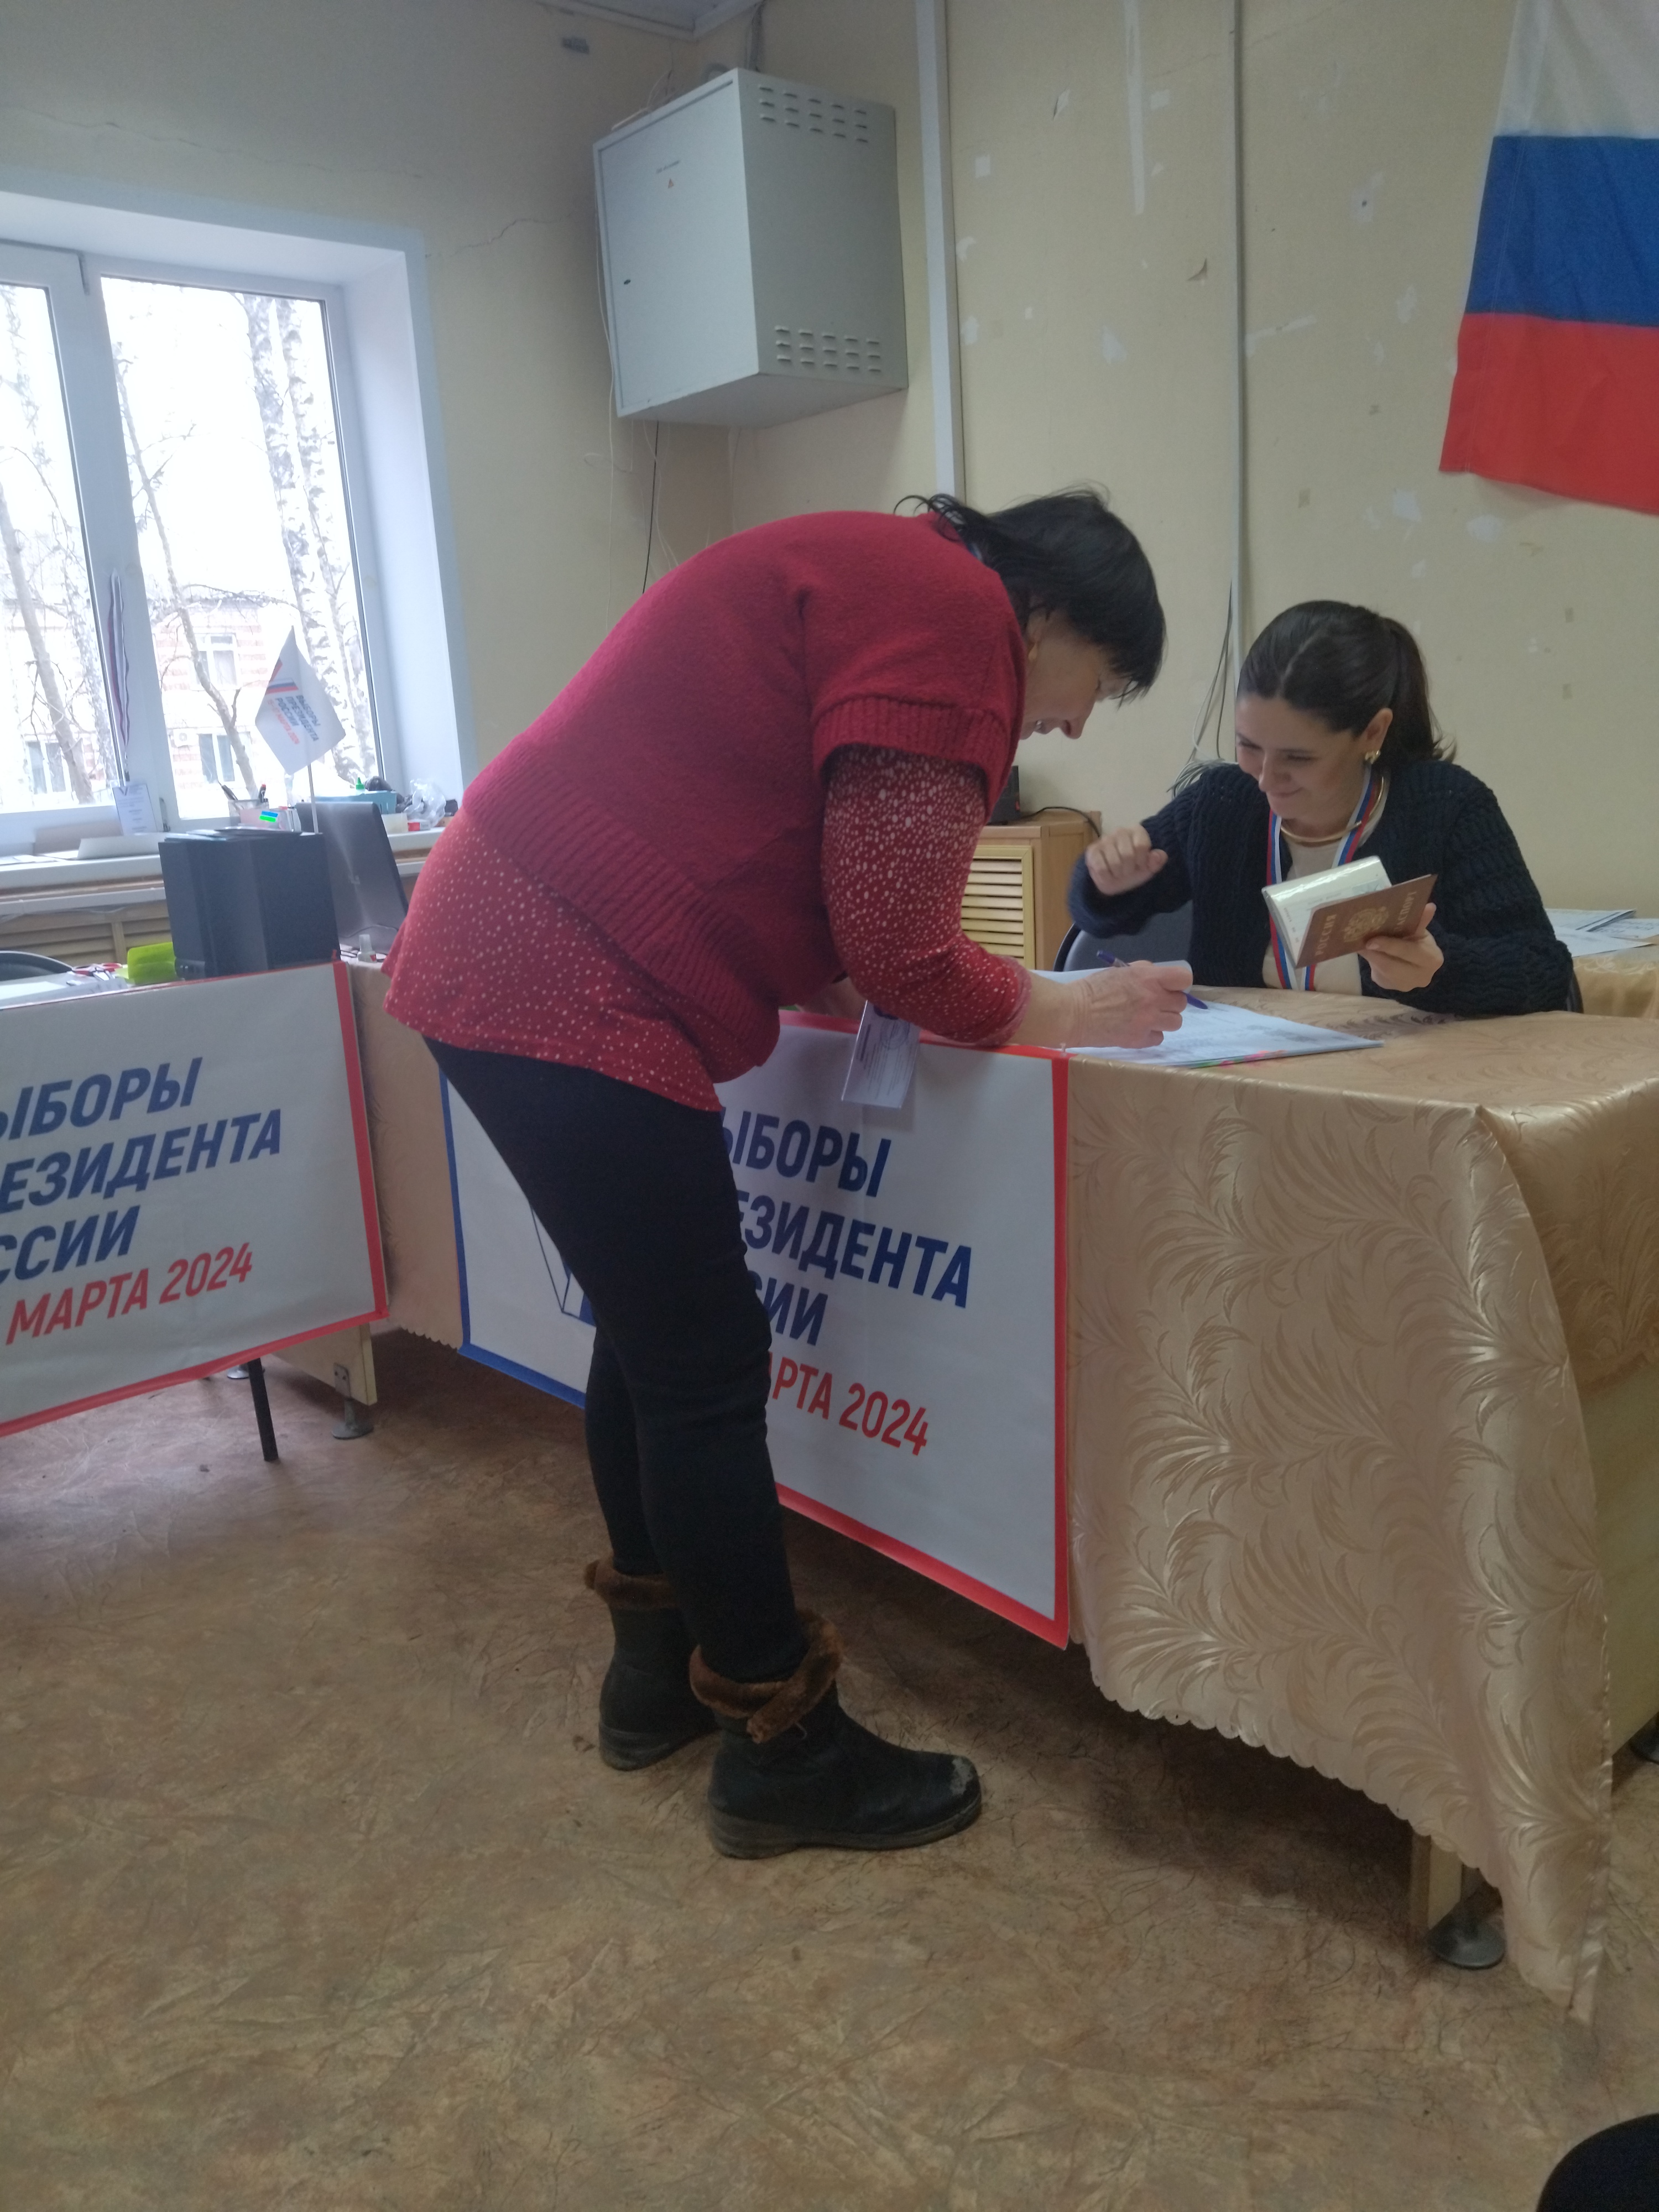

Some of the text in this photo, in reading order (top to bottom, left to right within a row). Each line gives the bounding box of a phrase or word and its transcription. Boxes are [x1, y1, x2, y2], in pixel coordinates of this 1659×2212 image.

[1314, 914, 1337, 956] РОССИЯ
[0, 1108, 281, 1215] ЕЗИДЕНТА
[6, 1243, 253, 1345] МАРТА 2024
[737, 1190, 972, 1309] ЗИДЕНТА
[748, 1270, 828, 1347] ИИ
[769, 1351, 929, 1456] РТА 2024
